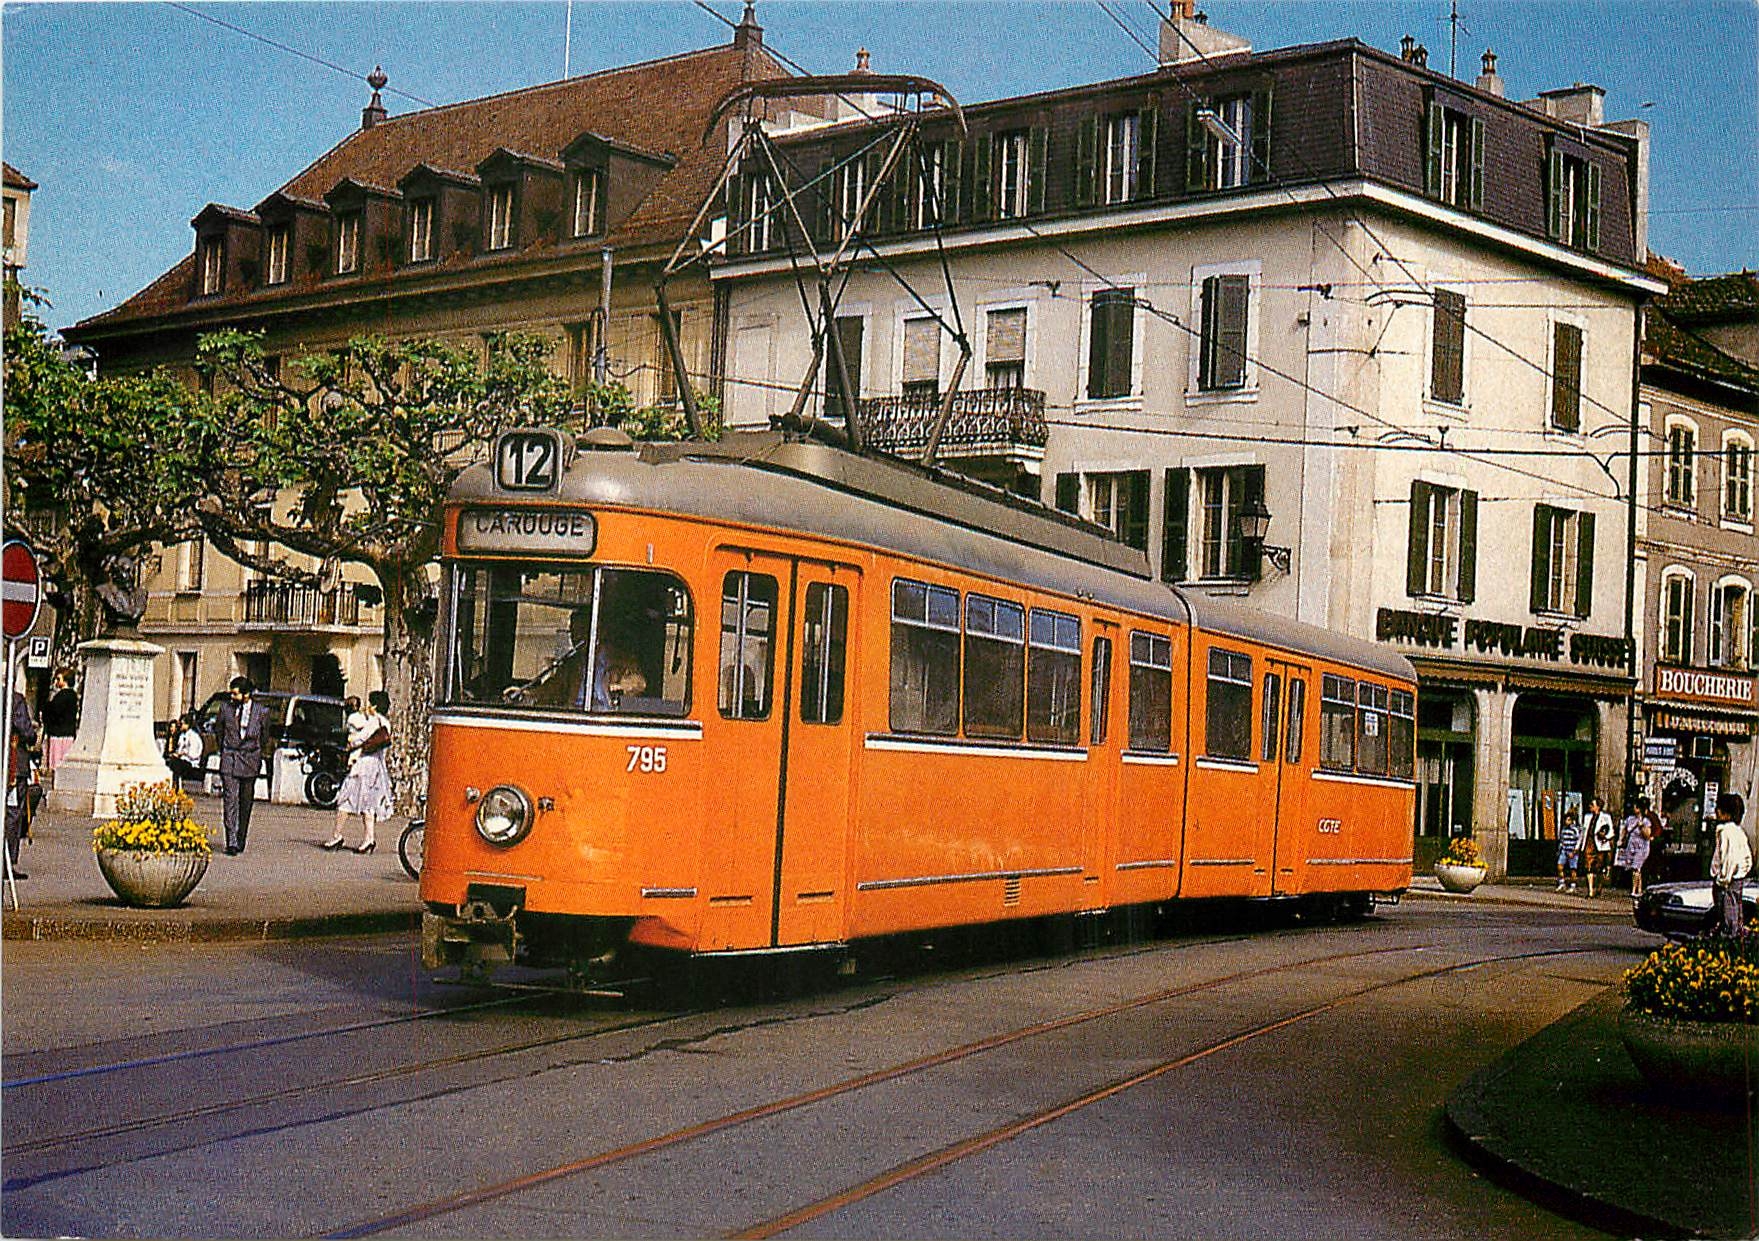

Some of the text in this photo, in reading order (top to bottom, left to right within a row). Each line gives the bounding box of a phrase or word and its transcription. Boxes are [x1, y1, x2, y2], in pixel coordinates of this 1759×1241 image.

[509, 440, 551, 485] 12
[476, 511, 584, 537] CAROUGE
[1377, 607, 1459, 649] BANQUE
[34, 641, 46, 655] P
[1660, 669, 1753, 701] BOUCHERIE
[626, 745, 667, 773] 795
[1318, 818, 1342, 834] CGTE
